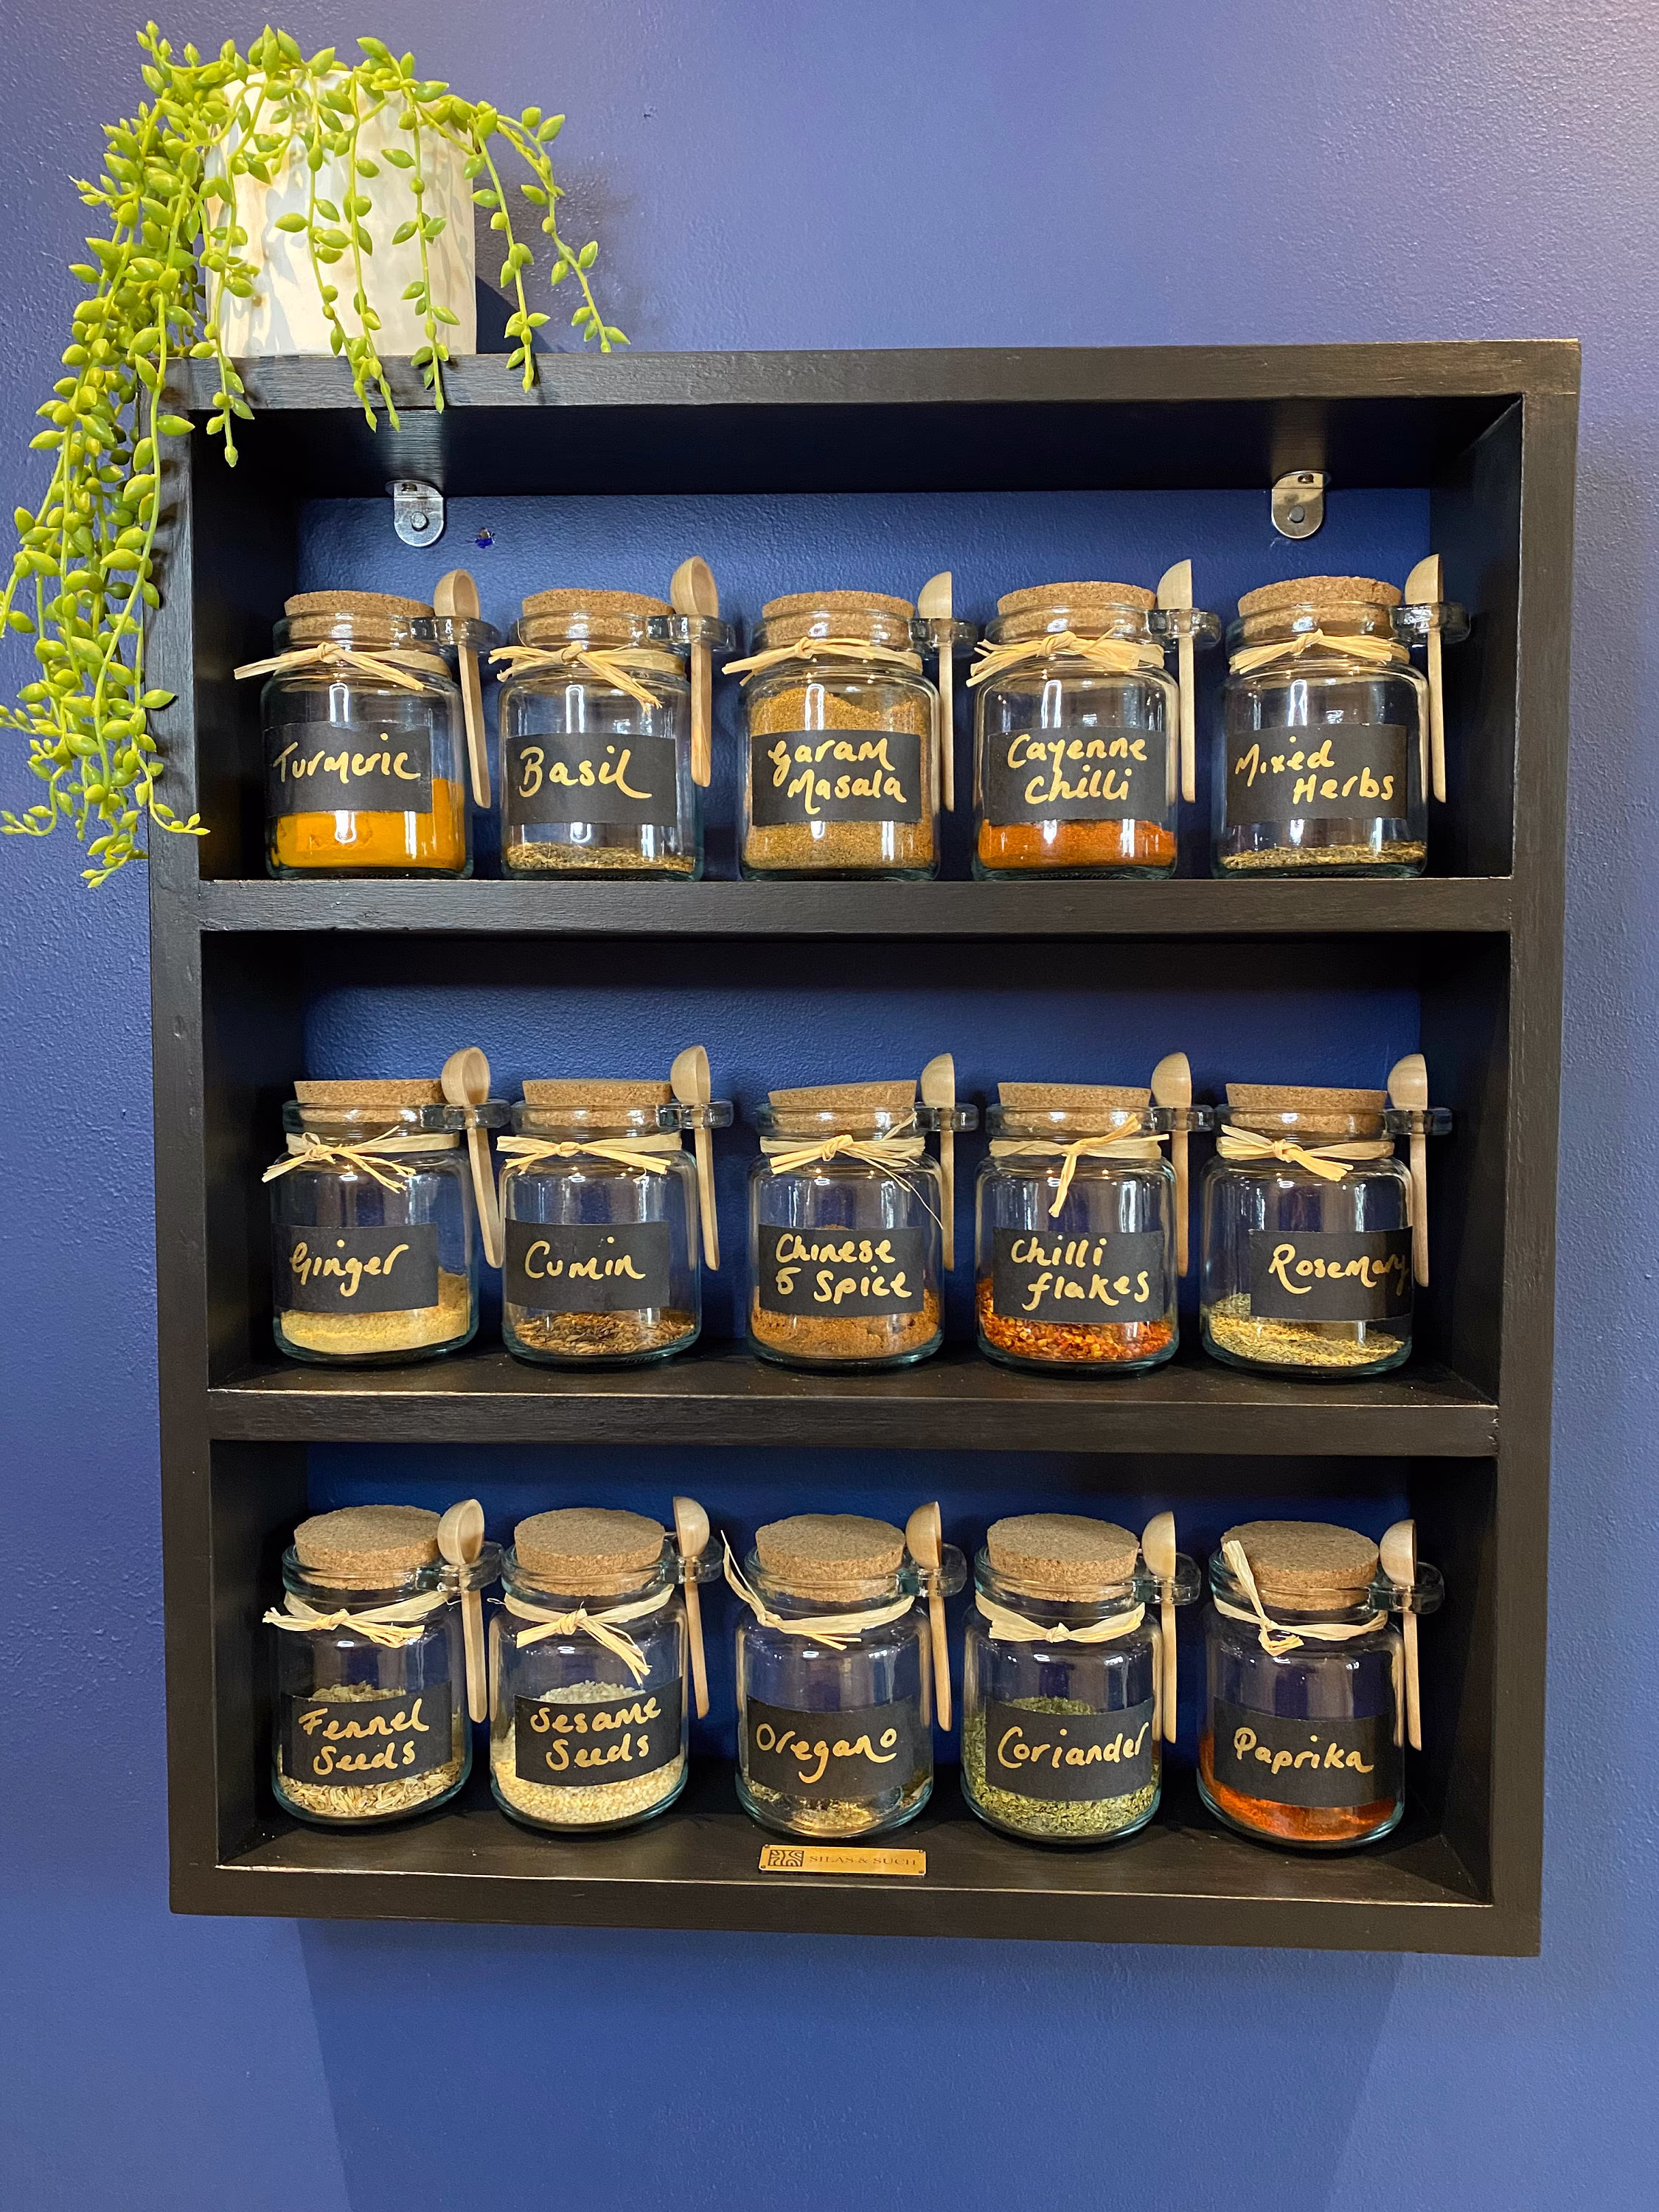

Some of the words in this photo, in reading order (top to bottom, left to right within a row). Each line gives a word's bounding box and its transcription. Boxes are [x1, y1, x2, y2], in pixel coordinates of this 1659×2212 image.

[274, 733, 421, 783] Turmeric
[519, 745, 653, 799] Basil
[768, 737, 895, 787] Garam
[1007, 734, 1148, 774] Cayenne
[1235, 735, 1335, 787] Mixed
[787, 770, 907, 814] Masala
[1293, 766, 1394, 804] Herbs
[290, 1239, 409, 1297] Ginger
[524, 1236, 646, 1280] Cumin
[775, 1233, 896, 1264] Chinese
[1268, 1243, 1409, 1297] Rosemary
[775, 1267, 802, 1295] 5
[813, 1265, 913, 1304] Spice
[299, 1697, 430, 1740] Fennel
[530, 1697, 661, 1733] Sesame
[313, 1740, 415, 1775] Seeds
[546, 1733, 650, 1771] Seeds
[756, 1723, 897, 1783] Oregano
[997, 1721, 1150, 1769] Coriander
[1234, 1727, 1374, 1774] Paprika
[810, 1855, 854, 1864] SILAS
[872, 1857, 917, 1865] SUCH
